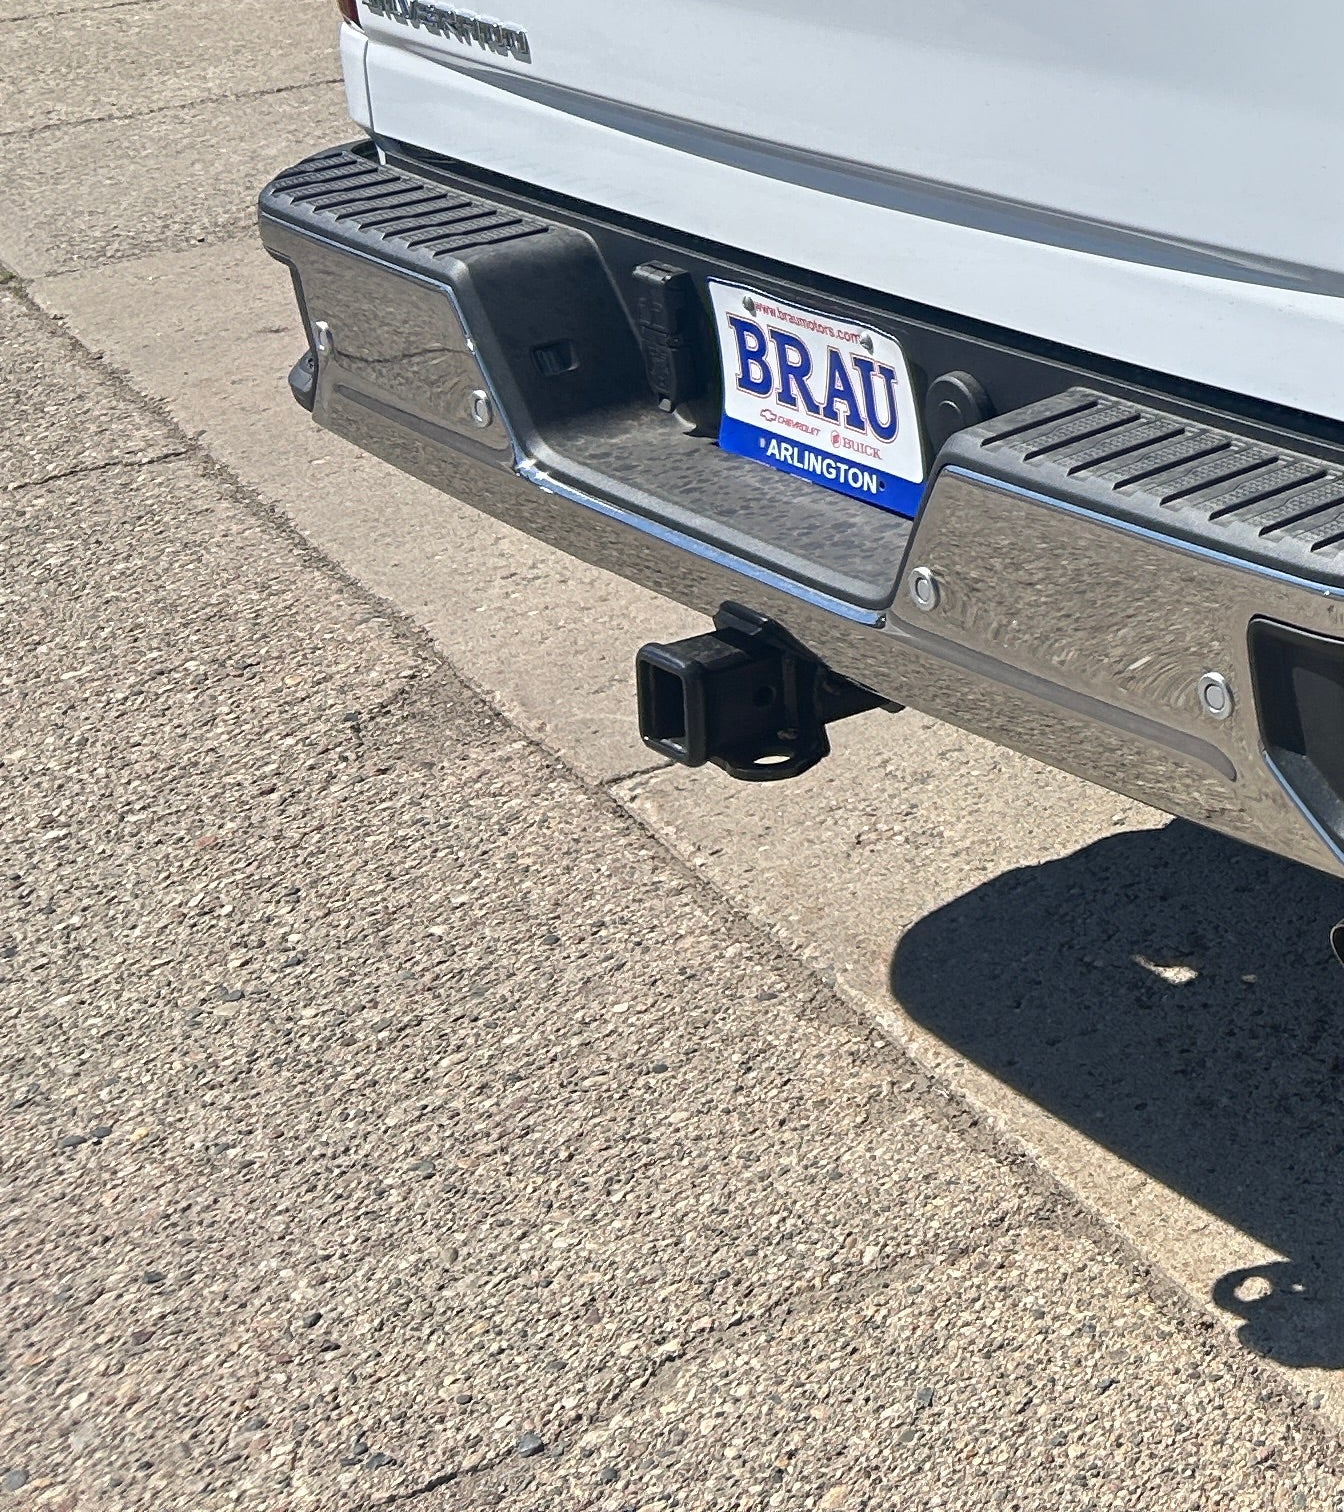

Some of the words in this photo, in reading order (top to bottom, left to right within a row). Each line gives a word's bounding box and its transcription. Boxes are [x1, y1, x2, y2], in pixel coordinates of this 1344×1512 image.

[726, 311, 899, 444] BRAU
[766, 437, 878, 494] ARLINGTON
[777, 415, 821, 437] CHEVROLET
[842, 436, 883, 460] BUICK
